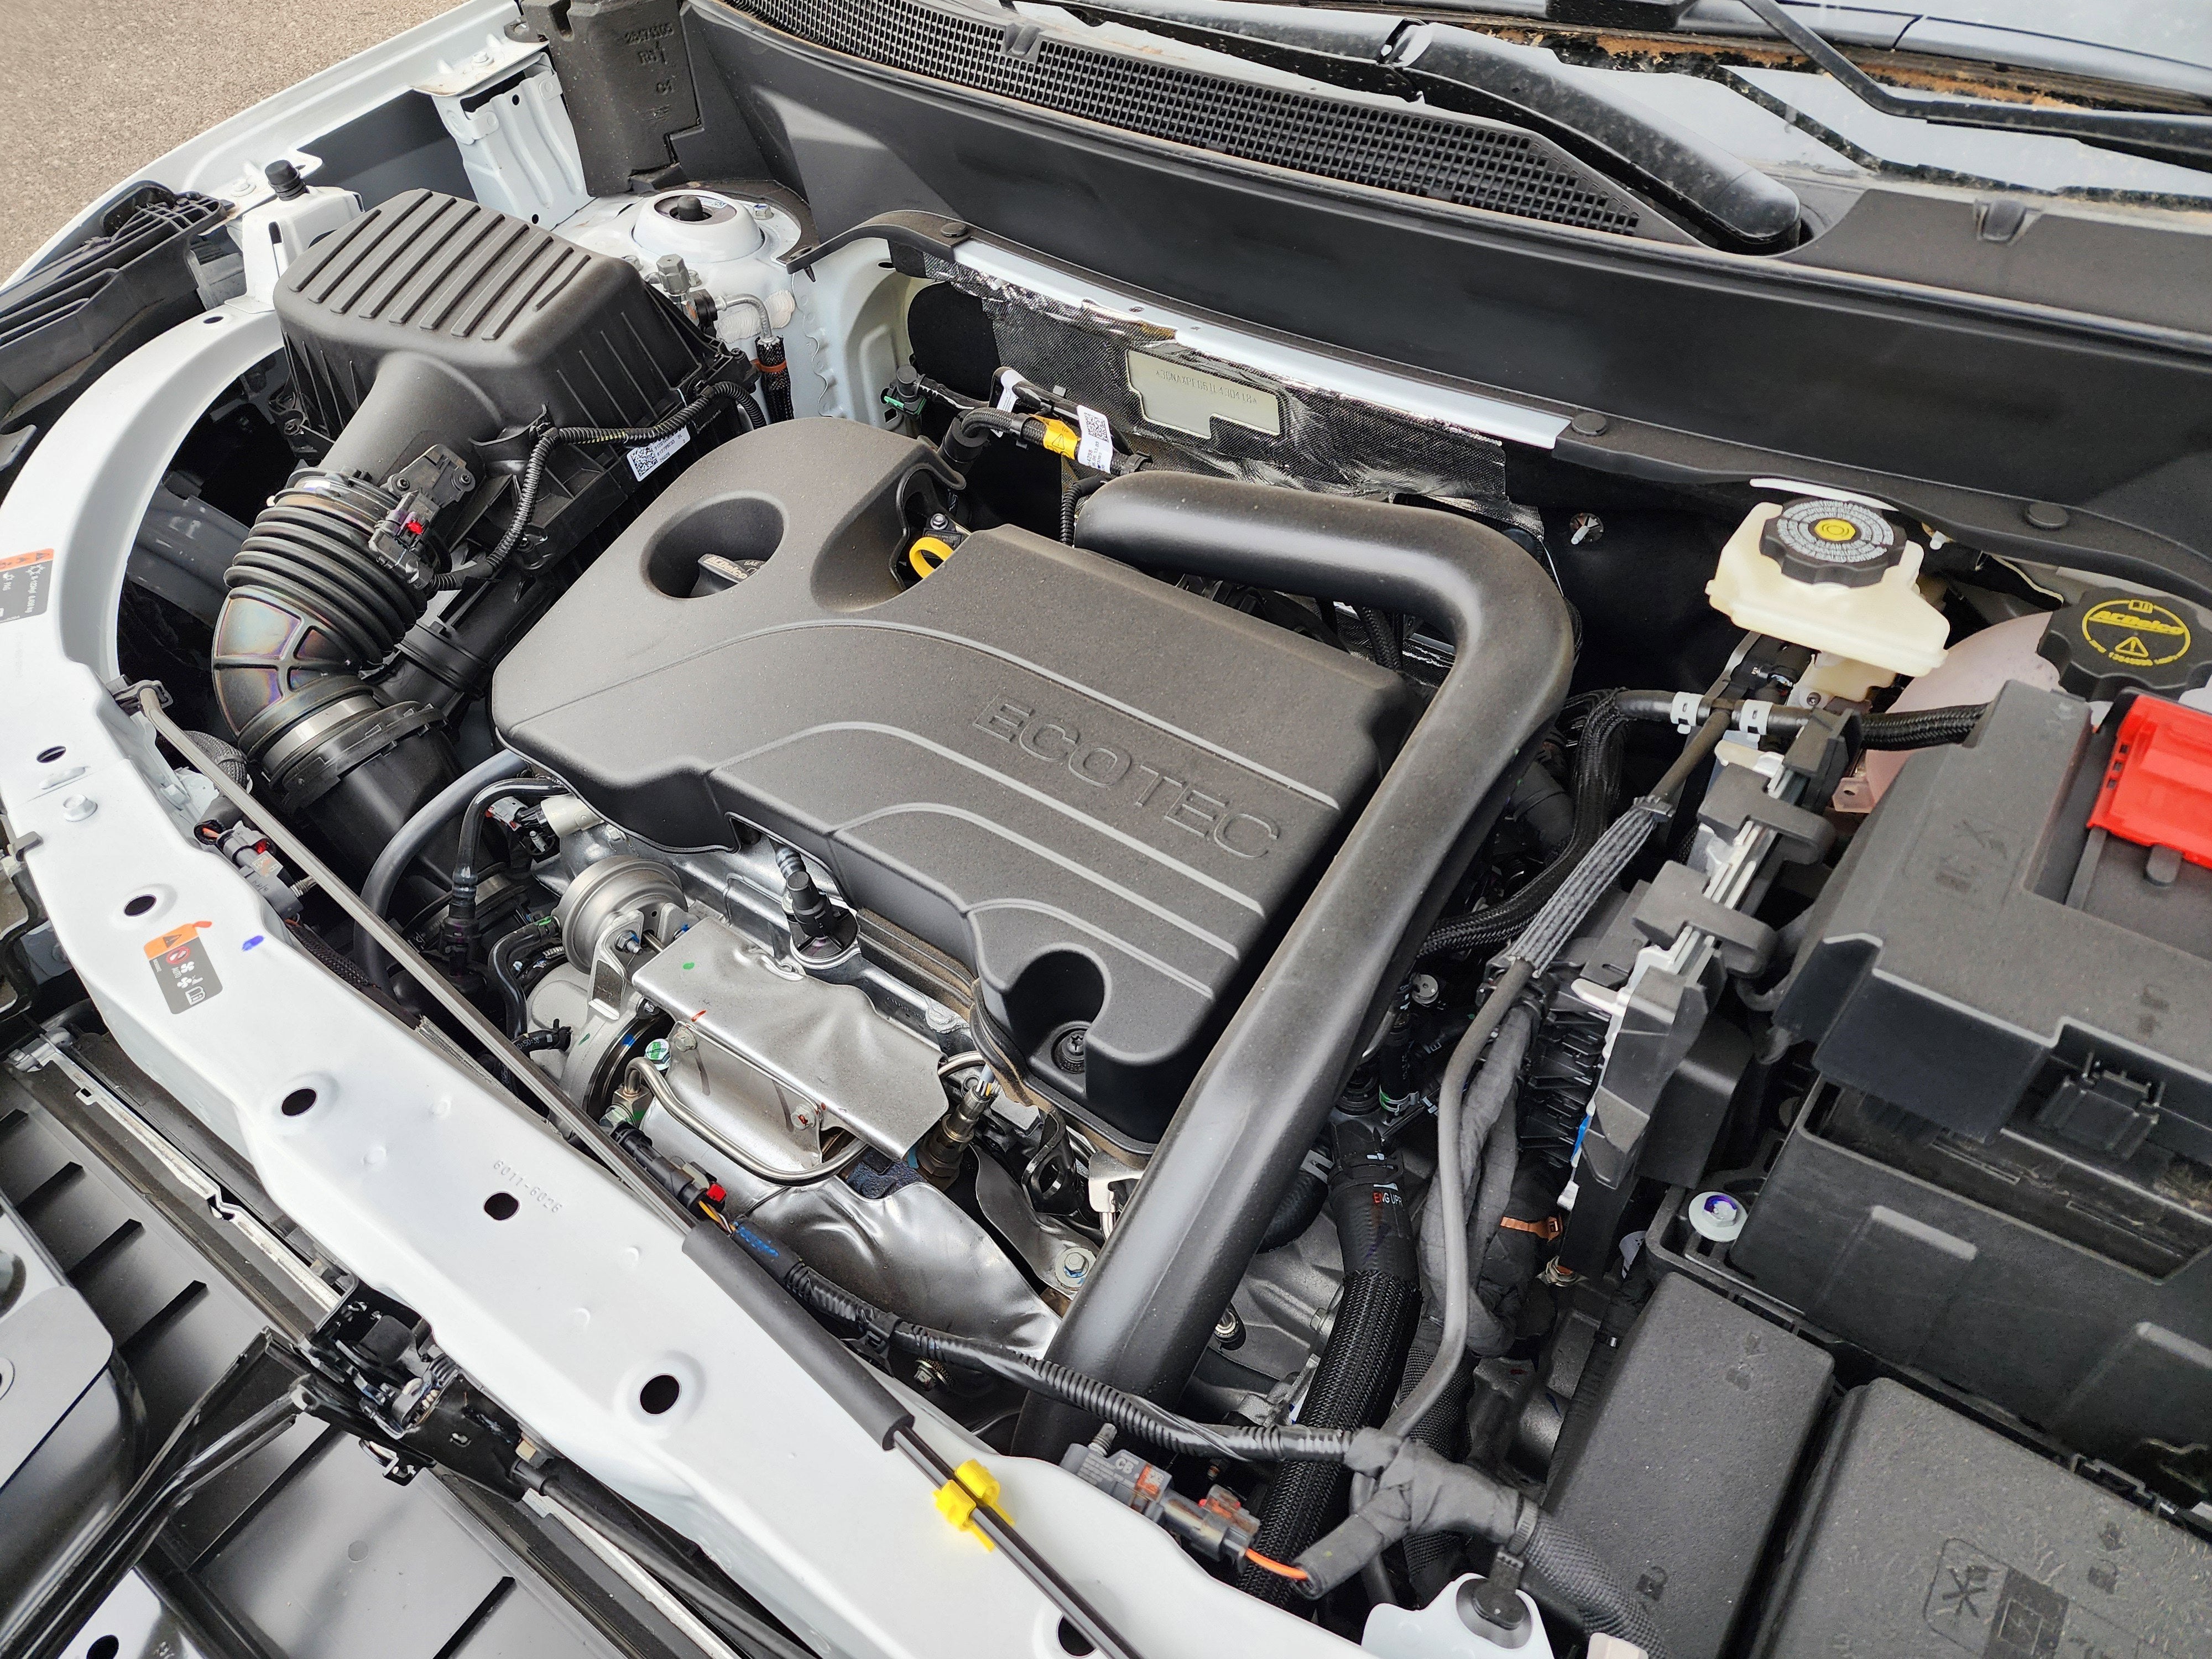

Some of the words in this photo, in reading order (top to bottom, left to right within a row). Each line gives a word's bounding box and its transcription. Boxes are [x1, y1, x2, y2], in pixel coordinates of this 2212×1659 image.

[703, 556, 748, 580] ACDelco
[2089, 610, 2185, 635] ACDelco
[973, 695, 1280, 858] ECOTEC
[1373, 1191, 1390, 1204] ENG
[1389, 1190, 1404, 1207] UPR
[1115, 1457, 1134, 1474] CB
